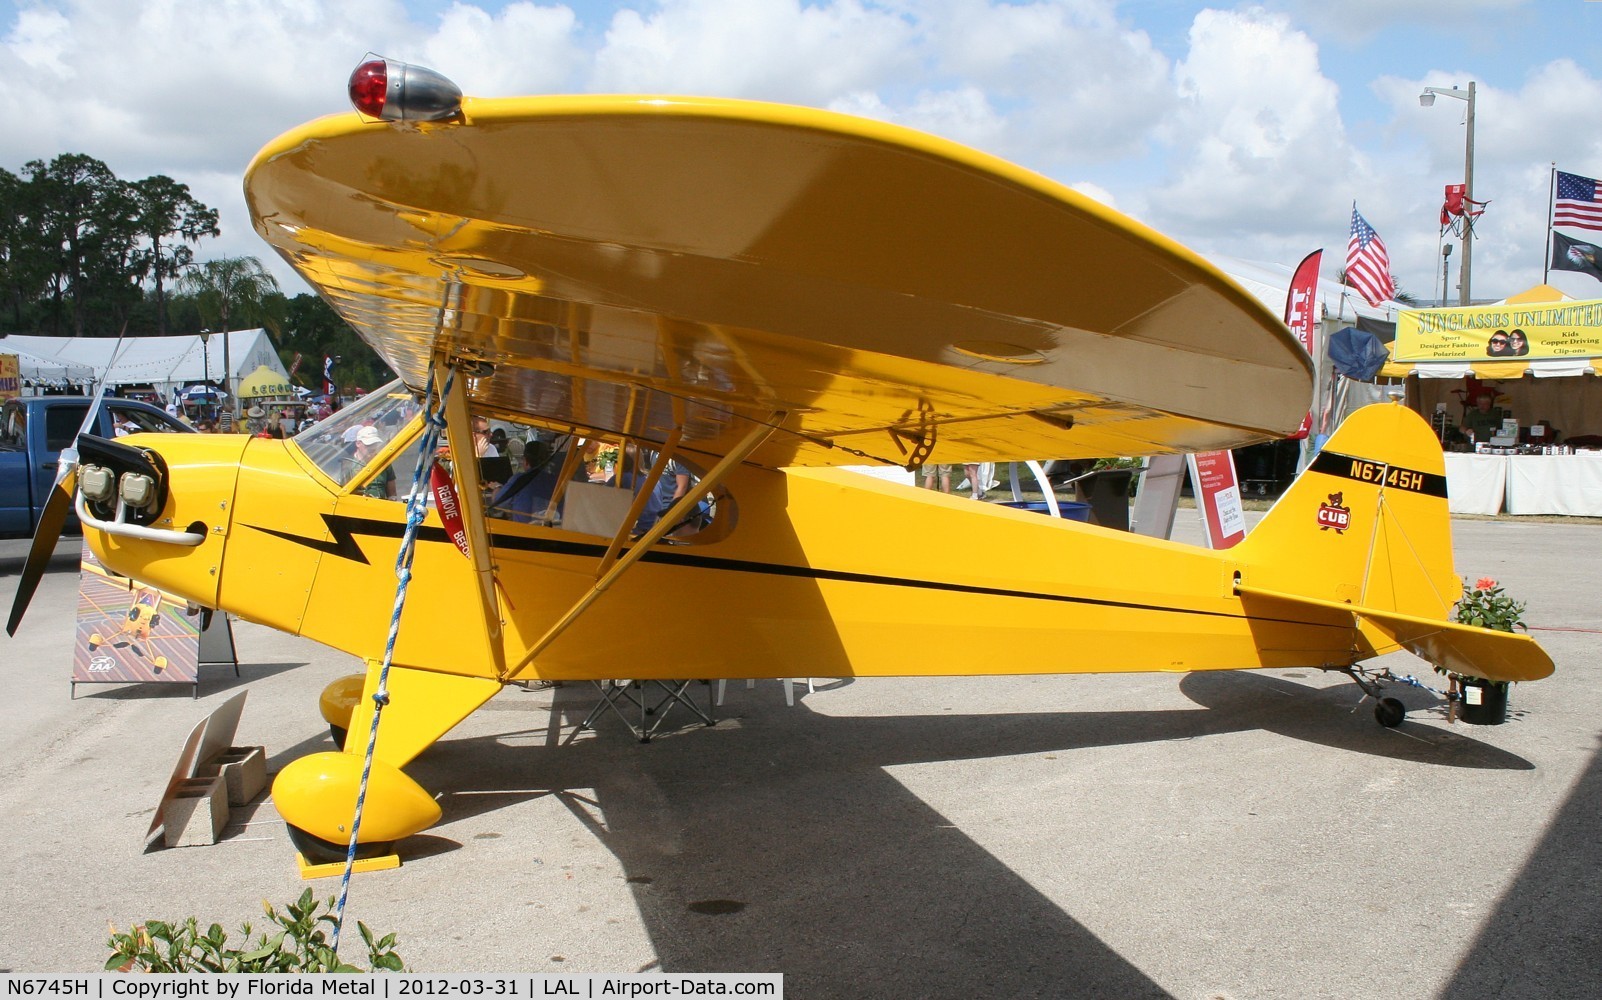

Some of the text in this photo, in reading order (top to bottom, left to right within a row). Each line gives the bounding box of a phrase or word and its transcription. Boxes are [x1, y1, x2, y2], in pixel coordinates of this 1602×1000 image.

[1417, 302, 1602, 335] SUNGLASSES UNLIMITED
[1441, 334, 1461, 342] Sport
[1541, 337, 1600, 347] Copper Driving
[1350, 460, 1423, 491] N6745H
[437, 484, 458, 520] REMOVE
[1319, 509, 1348, 525] CUB
[88, 663, 111, 671] EAA
